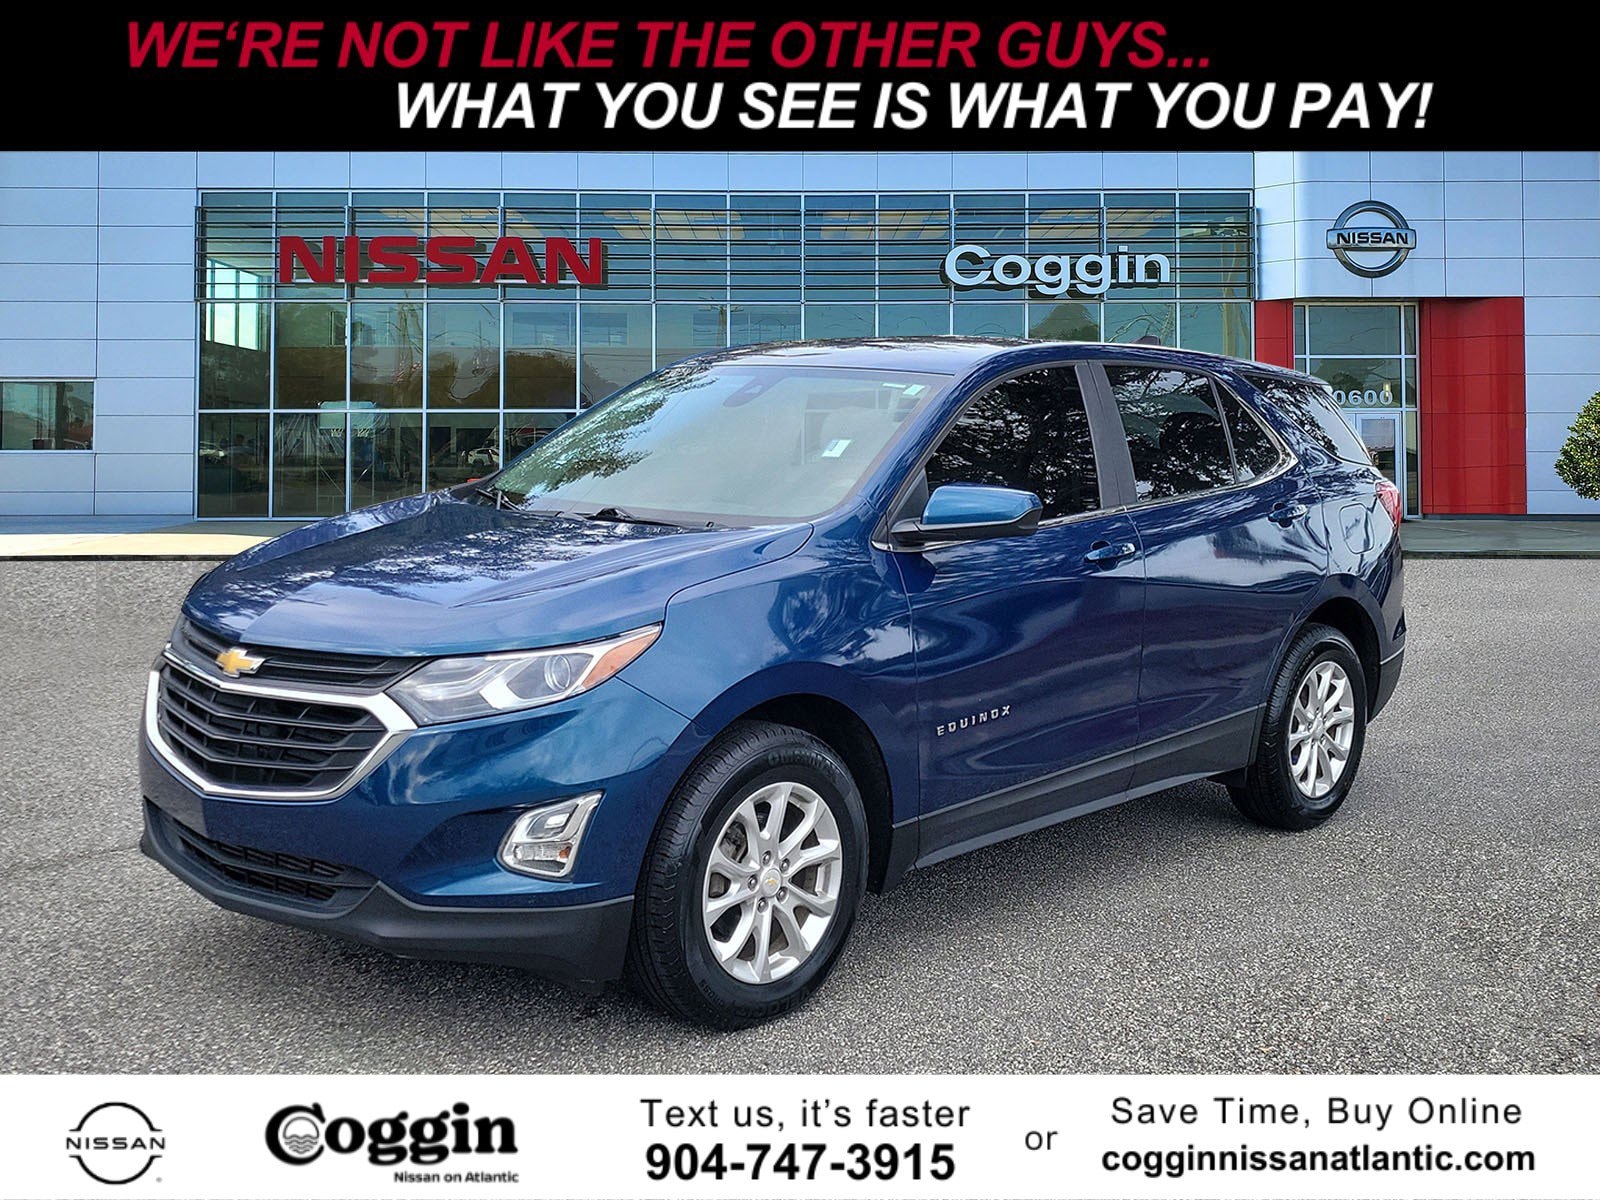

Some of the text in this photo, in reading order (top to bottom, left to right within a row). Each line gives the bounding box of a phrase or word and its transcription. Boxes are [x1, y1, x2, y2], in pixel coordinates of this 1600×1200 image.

[1336, 231, 1409, 245] NISSAN
[279, 235, 603, 285] NISSAN
[944, 244, 1171, 296] Coggin
[936, 704, 1011, 737] EQUINOX
